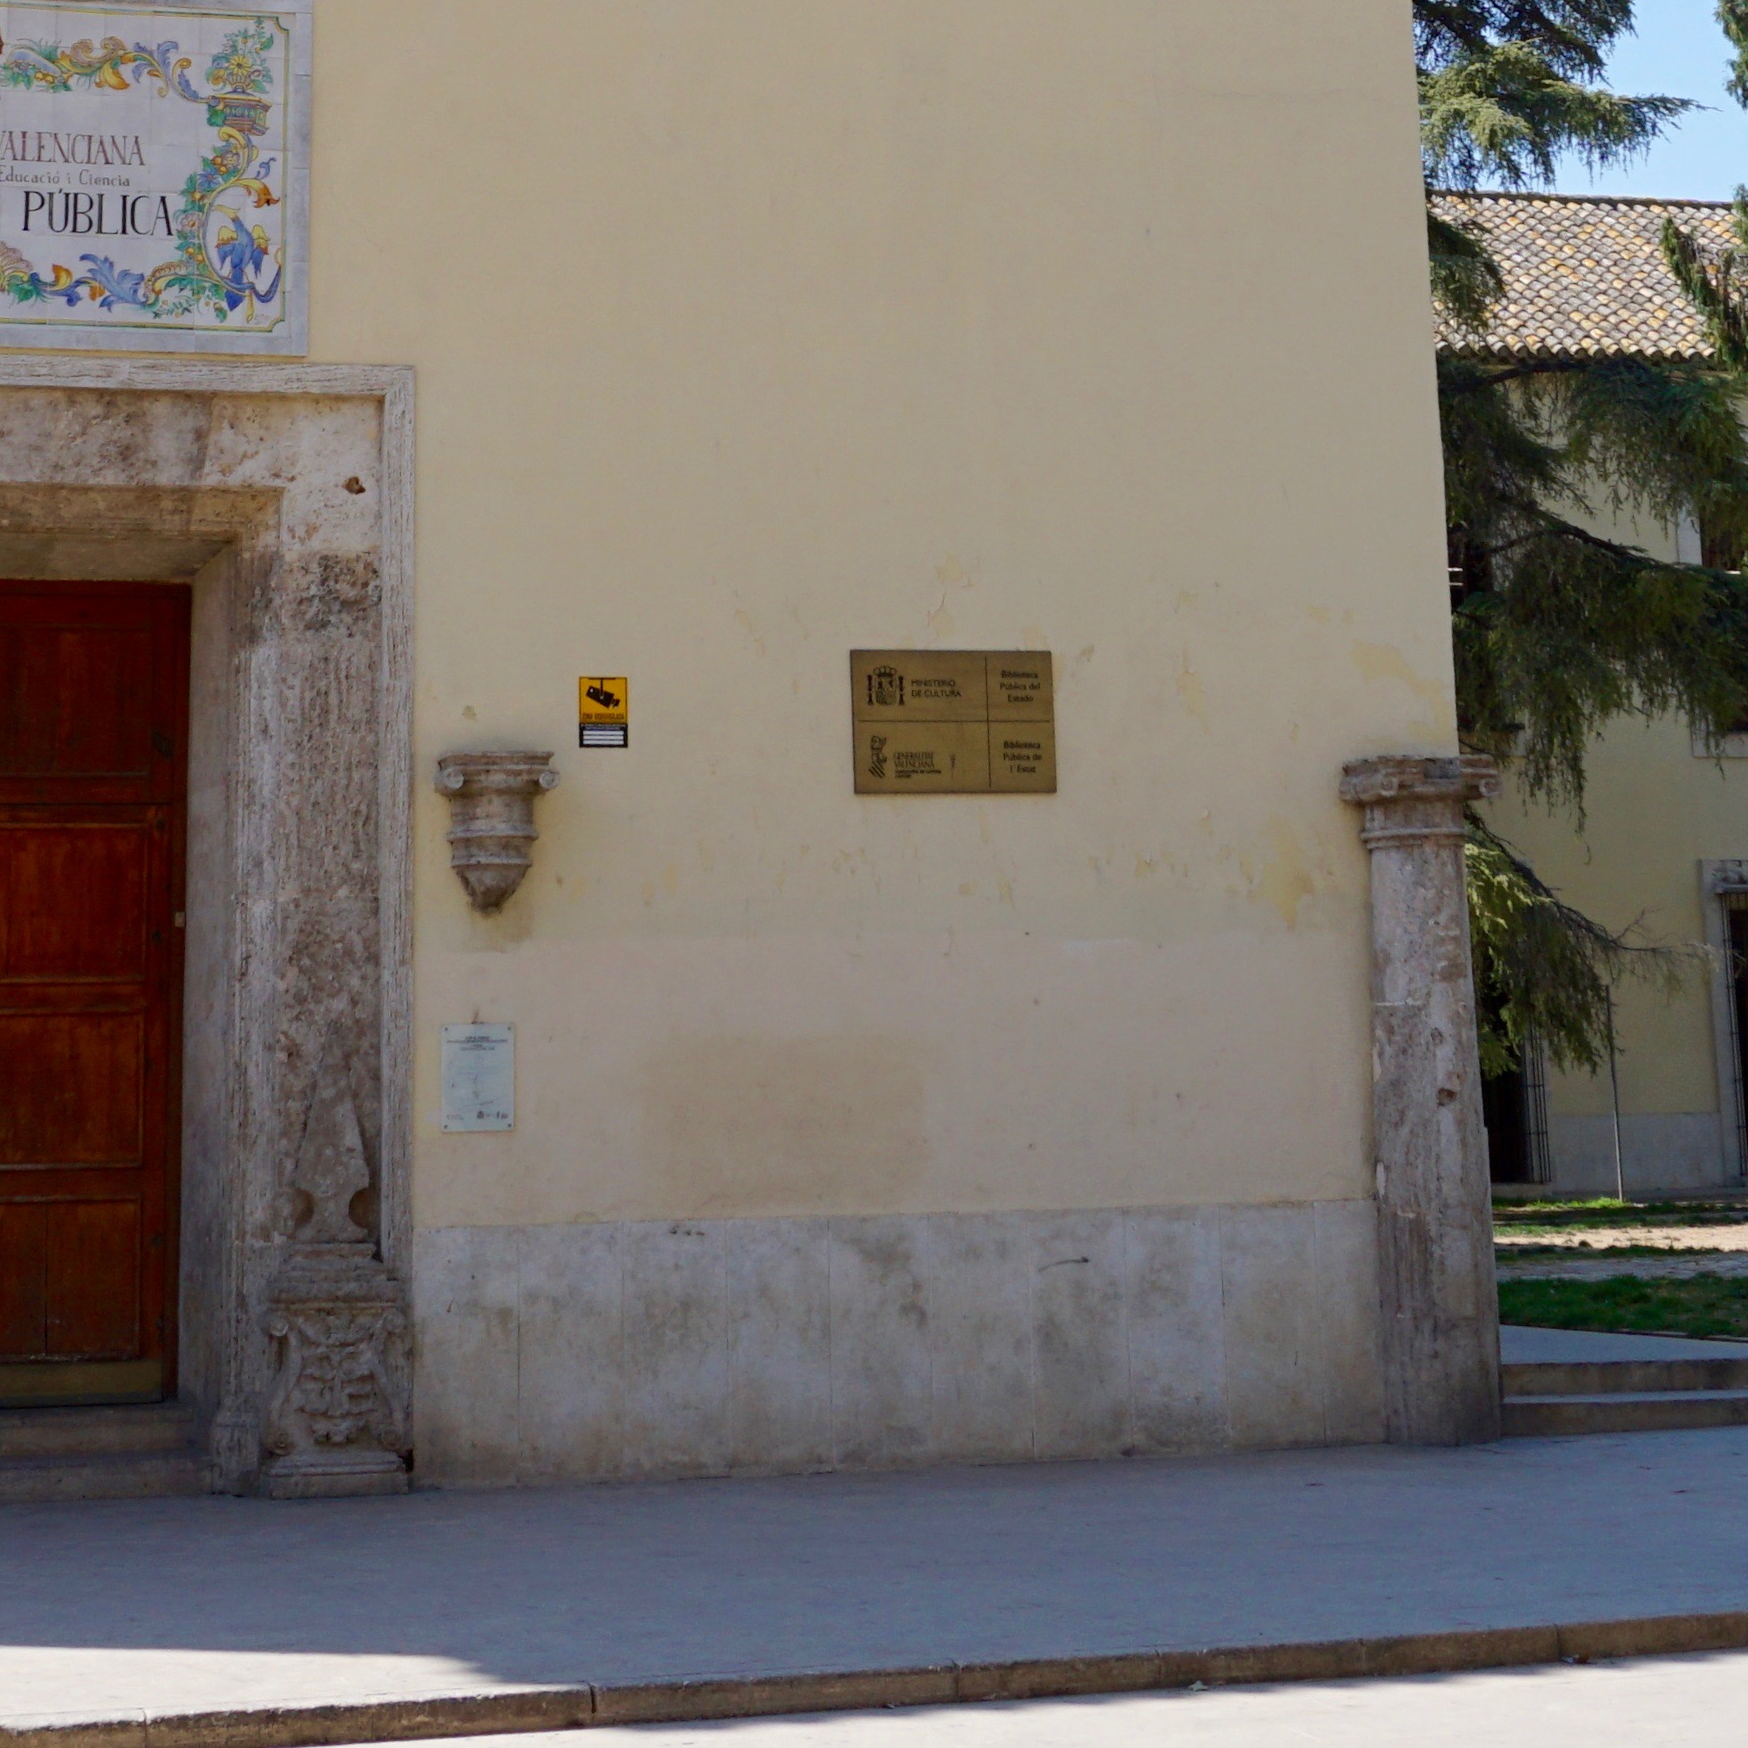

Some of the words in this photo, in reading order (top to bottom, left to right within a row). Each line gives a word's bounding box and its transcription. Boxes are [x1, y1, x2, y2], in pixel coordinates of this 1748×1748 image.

[66, 172, 71, 185] i
[21, 186, 175, 238] PÚBLICA
[1001, 671, 1038, 679] Biblioteca
[911, 679, 955, 687] MINISTERIO
[1029, 681, 1040, 690] del
[911, 689, 922, 698] DE
[924, 689, 962, 698] CULTURA
[1007, 694, 1034, 703] Estado
[1003, 741, 1041, 749] Biblioteca
[1032, 752, 1042, 761] de
